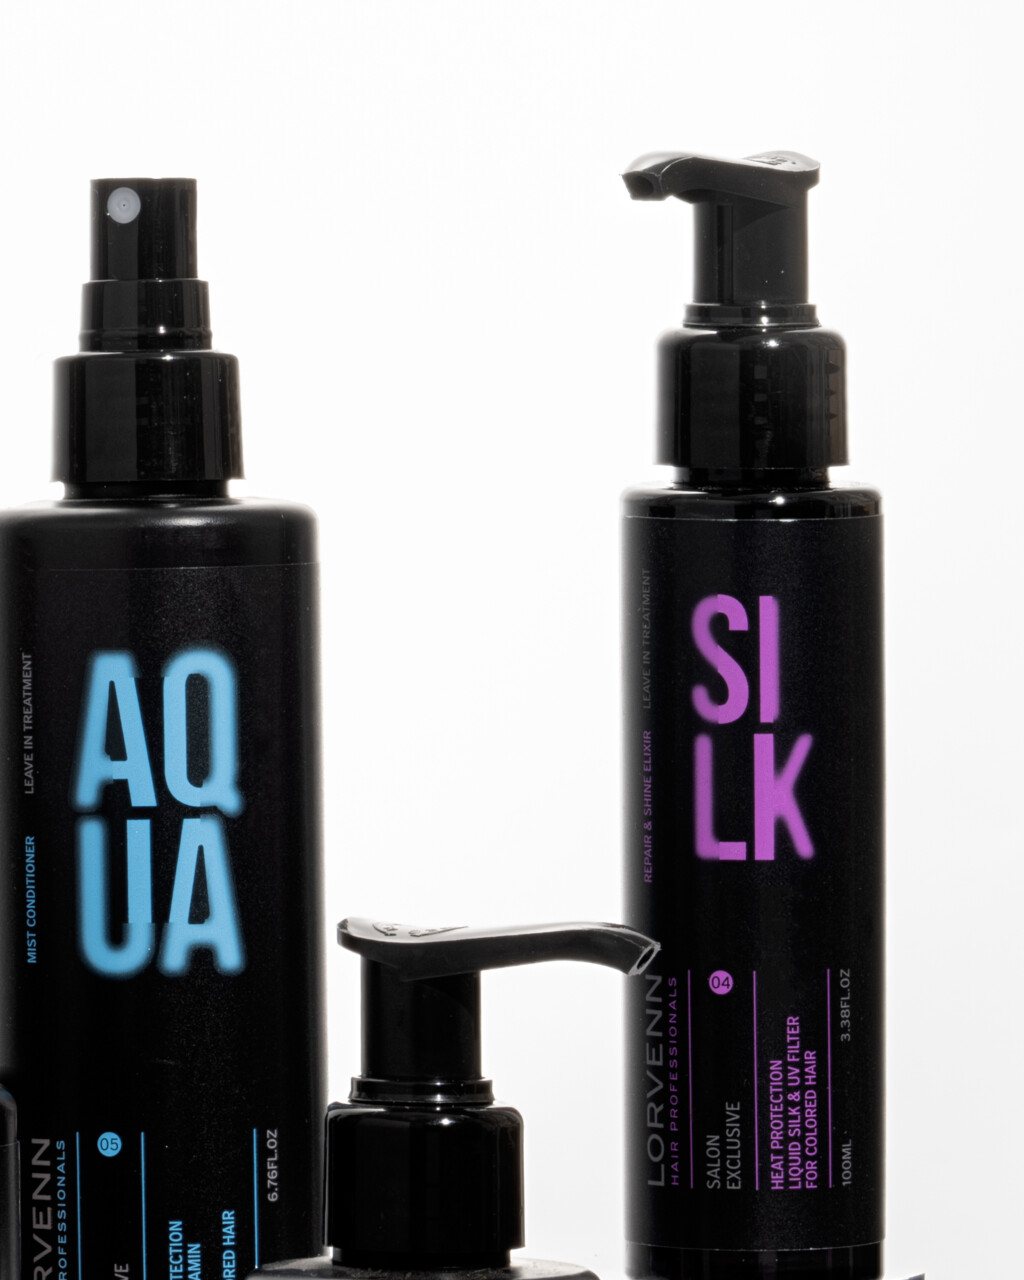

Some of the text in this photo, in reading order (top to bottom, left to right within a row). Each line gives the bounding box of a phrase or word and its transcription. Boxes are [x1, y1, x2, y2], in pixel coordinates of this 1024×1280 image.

[642, 569, 651, 709] LEAVE IN TREATMENT
[692, 594, 779, 724] SI
[22, 653, 34, 794] LEAVE IN TREATMENT
[74, 647, 242, 814] AQ
[643, 730, 652, 883] REPAIR & SHINE ELIXIR
[694, 733, 815, 861] LK
[25, 836, 37, 963] MIST CONDITIONER
[79, 815, 244, 977] UA
[711, 976, 730, 989] 04
[101, 1138, 118, 1151] 05
[646, 974, 664, 1186] LORVENN
[669, 977, 679, 1185] HAIR PROFESSIONALS
[770, 1060, 784, 1189] HEAT PROTECTION
[787, 1016, 804, 1189] LIQUID SILK & UV FILTER
[804, 1050, 817, 1188] FOR COLORED HAIR
[267, 1129, 278, 1201] 6.76FL.OZ
[707, 1135, 720, 1189] SALON
[726, 1101, 740, 1189] EXCLUSIVE
[842, 1139, 851, 1186] 100ML
[222, 1210, 235, 1245] HAIR
